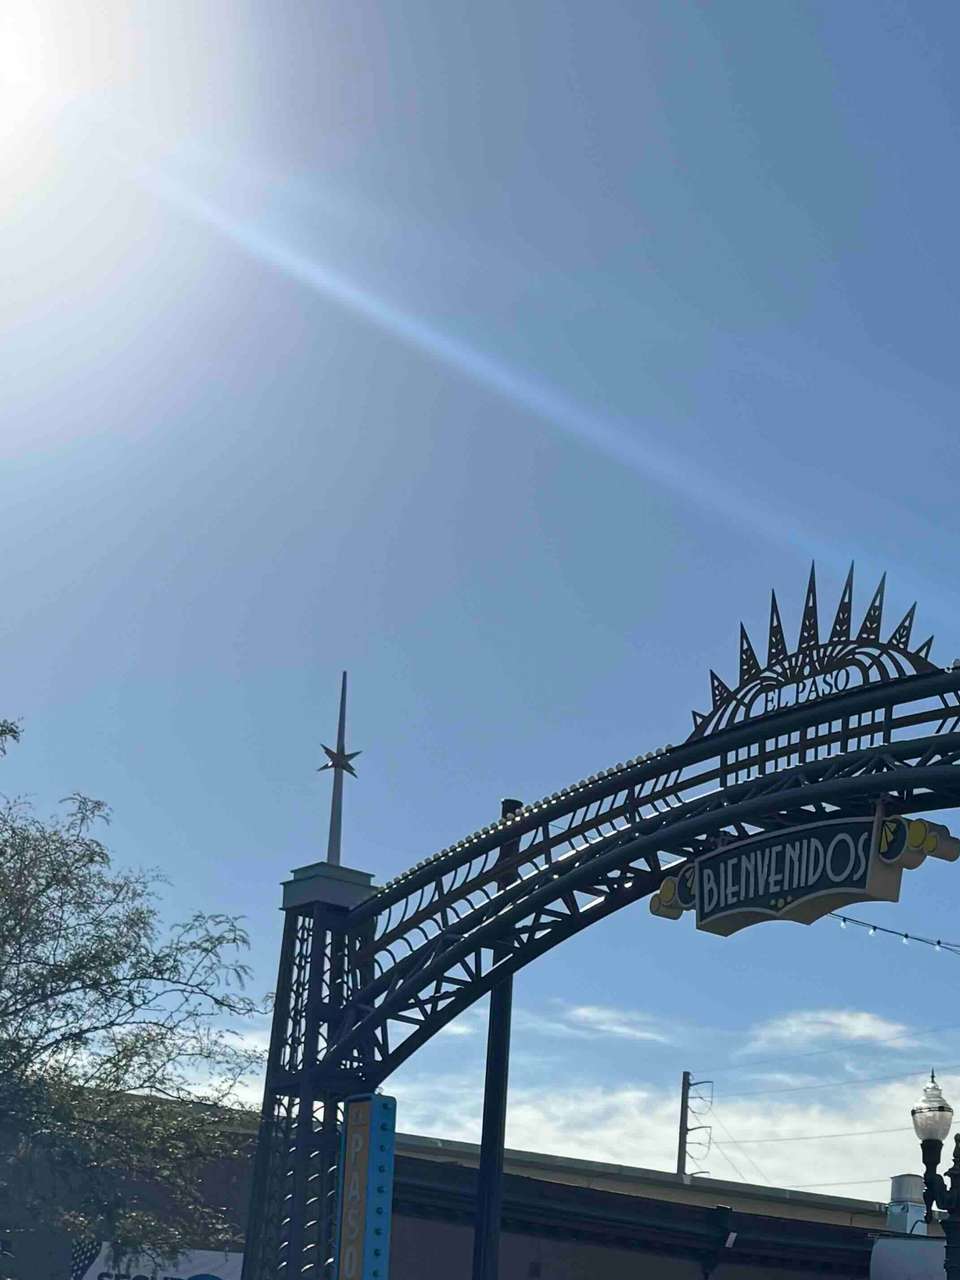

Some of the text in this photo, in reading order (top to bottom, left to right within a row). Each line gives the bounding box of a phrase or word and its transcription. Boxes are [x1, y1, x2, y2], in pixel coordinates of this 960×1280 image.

[764, 666, 850, 713] EL PASO
[703, 832, 869, 914] BIENVENIDOS
[344, 1132, 364, 1280] PASO
